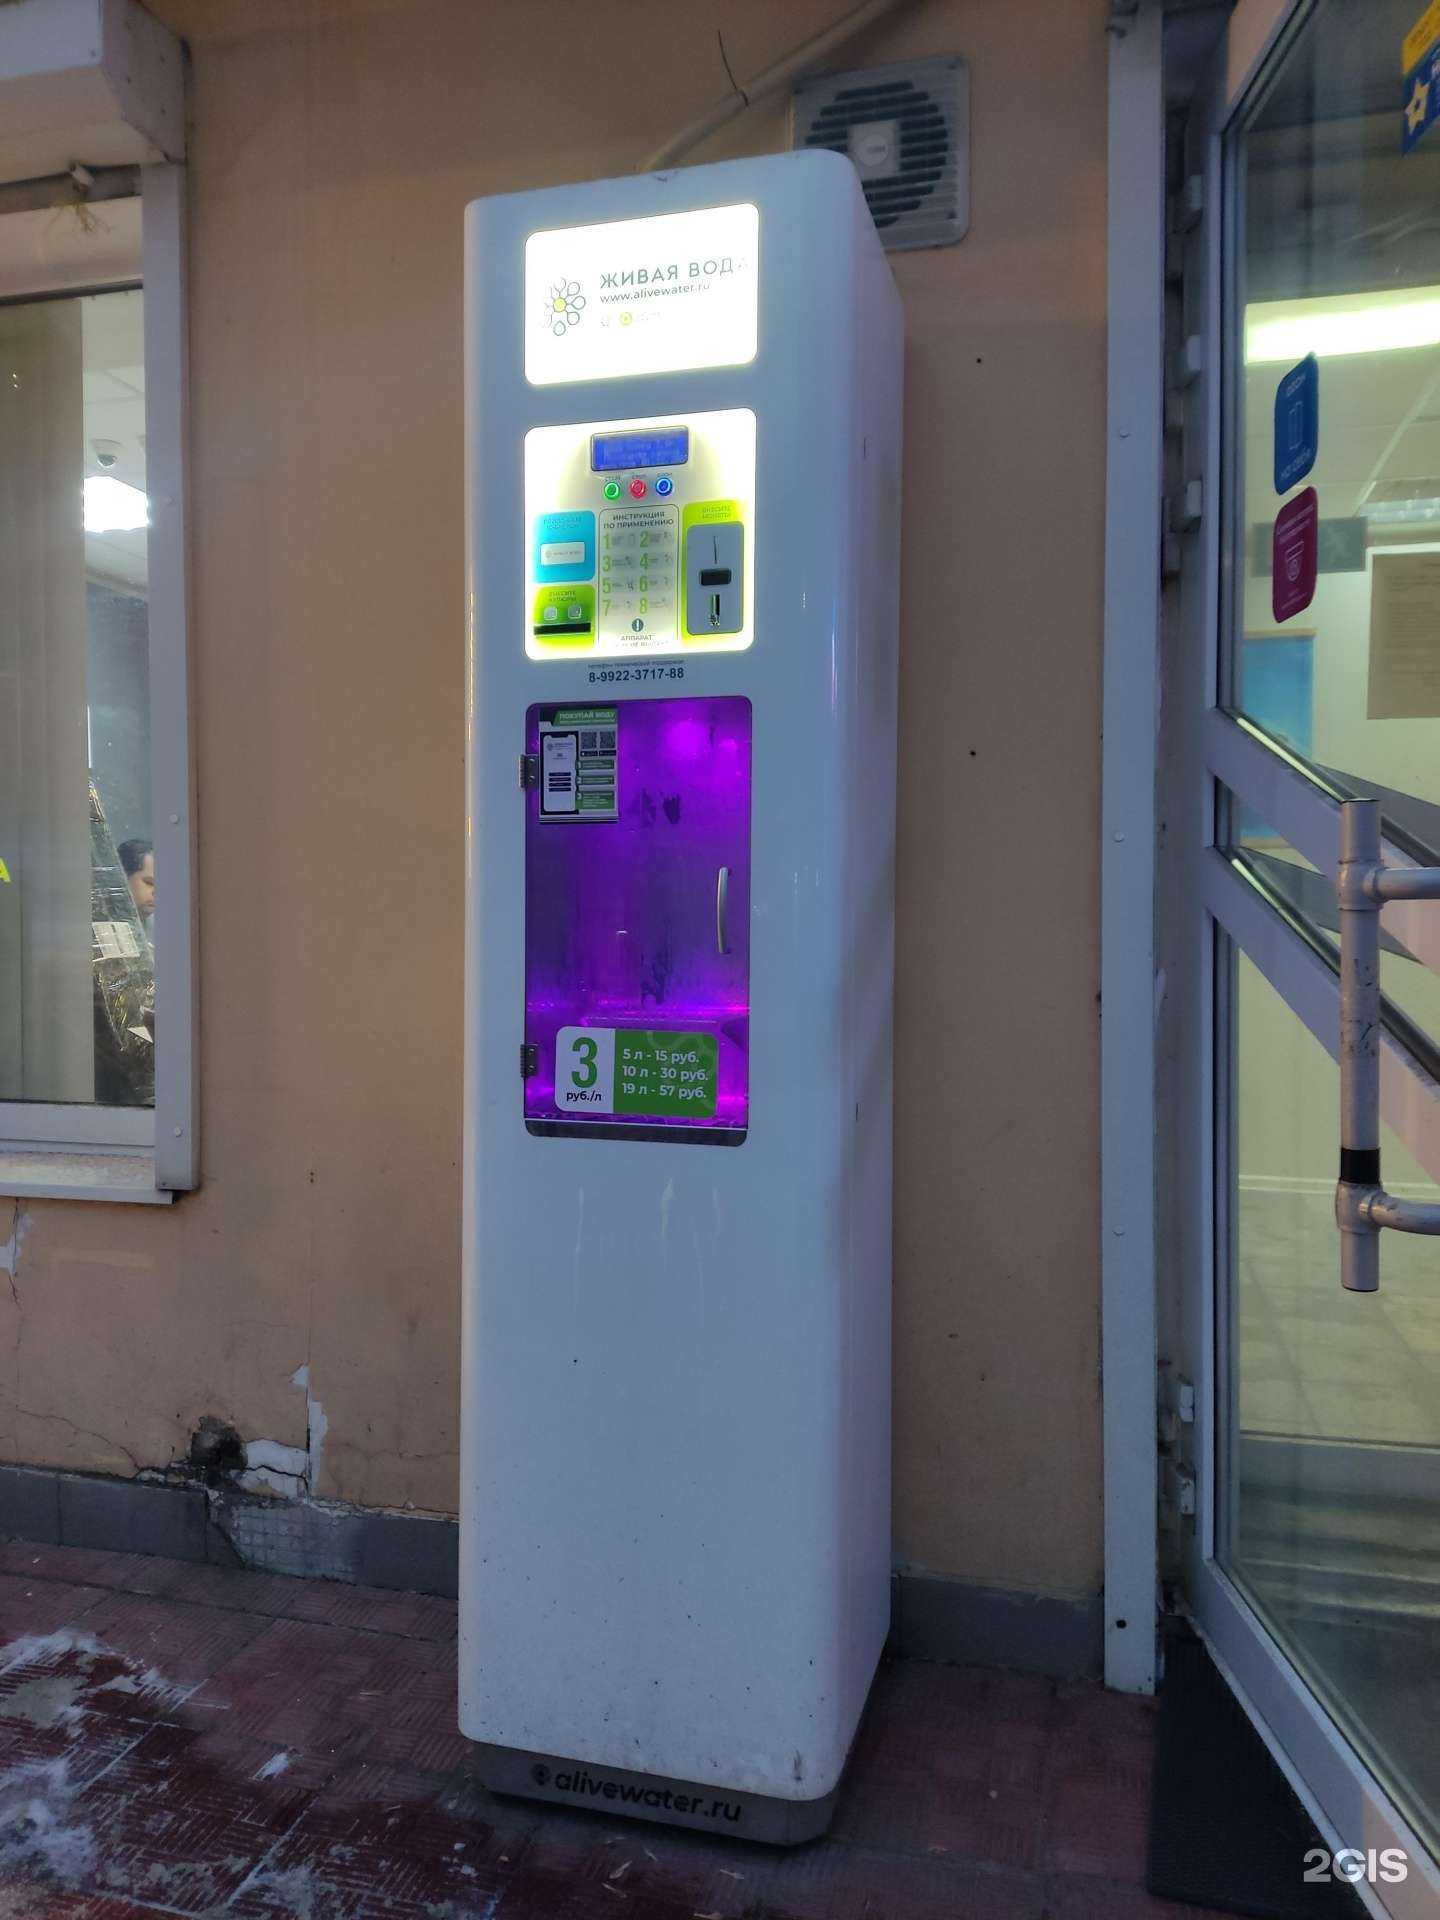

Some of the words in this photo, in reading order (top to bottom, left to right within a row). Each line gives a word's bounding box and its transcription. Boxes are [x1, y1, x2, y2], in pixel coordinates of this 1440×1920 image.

[600, 264, 678, 289] ЖИВАЯ
[688, 257, 746, 278] ВОД
[600, 283, 711, 304] www.alivewater.ru
[612, 511, 665, 521] ИНСТРУКЦИЯ
[617, 518, 674, 528] ПРИМЕНЕНИЮ
[603, 533, 611, 549] 1
[639, 530, 648, 548] 2
[603, 556, 610, 572] 3
[639, 553, 649, 570] 4
[602, 578, 611, 593] 5
[639, 576, 648, 592] 6
[602, 599, 612, 616] 7
[639, 598, 648, 614] 8
[588, 667, 684, 683] 8-9922-3717-88
[571, 1037, 598, 1088] 3
[622, 1049, 631, 1060] 5
[634, 1051, 643, 1061] л
[655, 1050, 668, 1062] 15
[671, 1051, 700, 1064] руб.
[622, 1065, 636, 1077] 10
[639, 1068, 649, 1079] л
[660, 1068, 677, 1080] 30
[680, 1069, 709, 1082] руб.
[566, 1090, 602, 1102] руб./л
[622, 1083, 636, 1095] 19
[638, 1085, 648, 1096] л
[659, 1085, 674, 1097] 57
[678, 1086, 707, 1099] руб.
[554, 1770, 742, 1822] alivewater.ru
